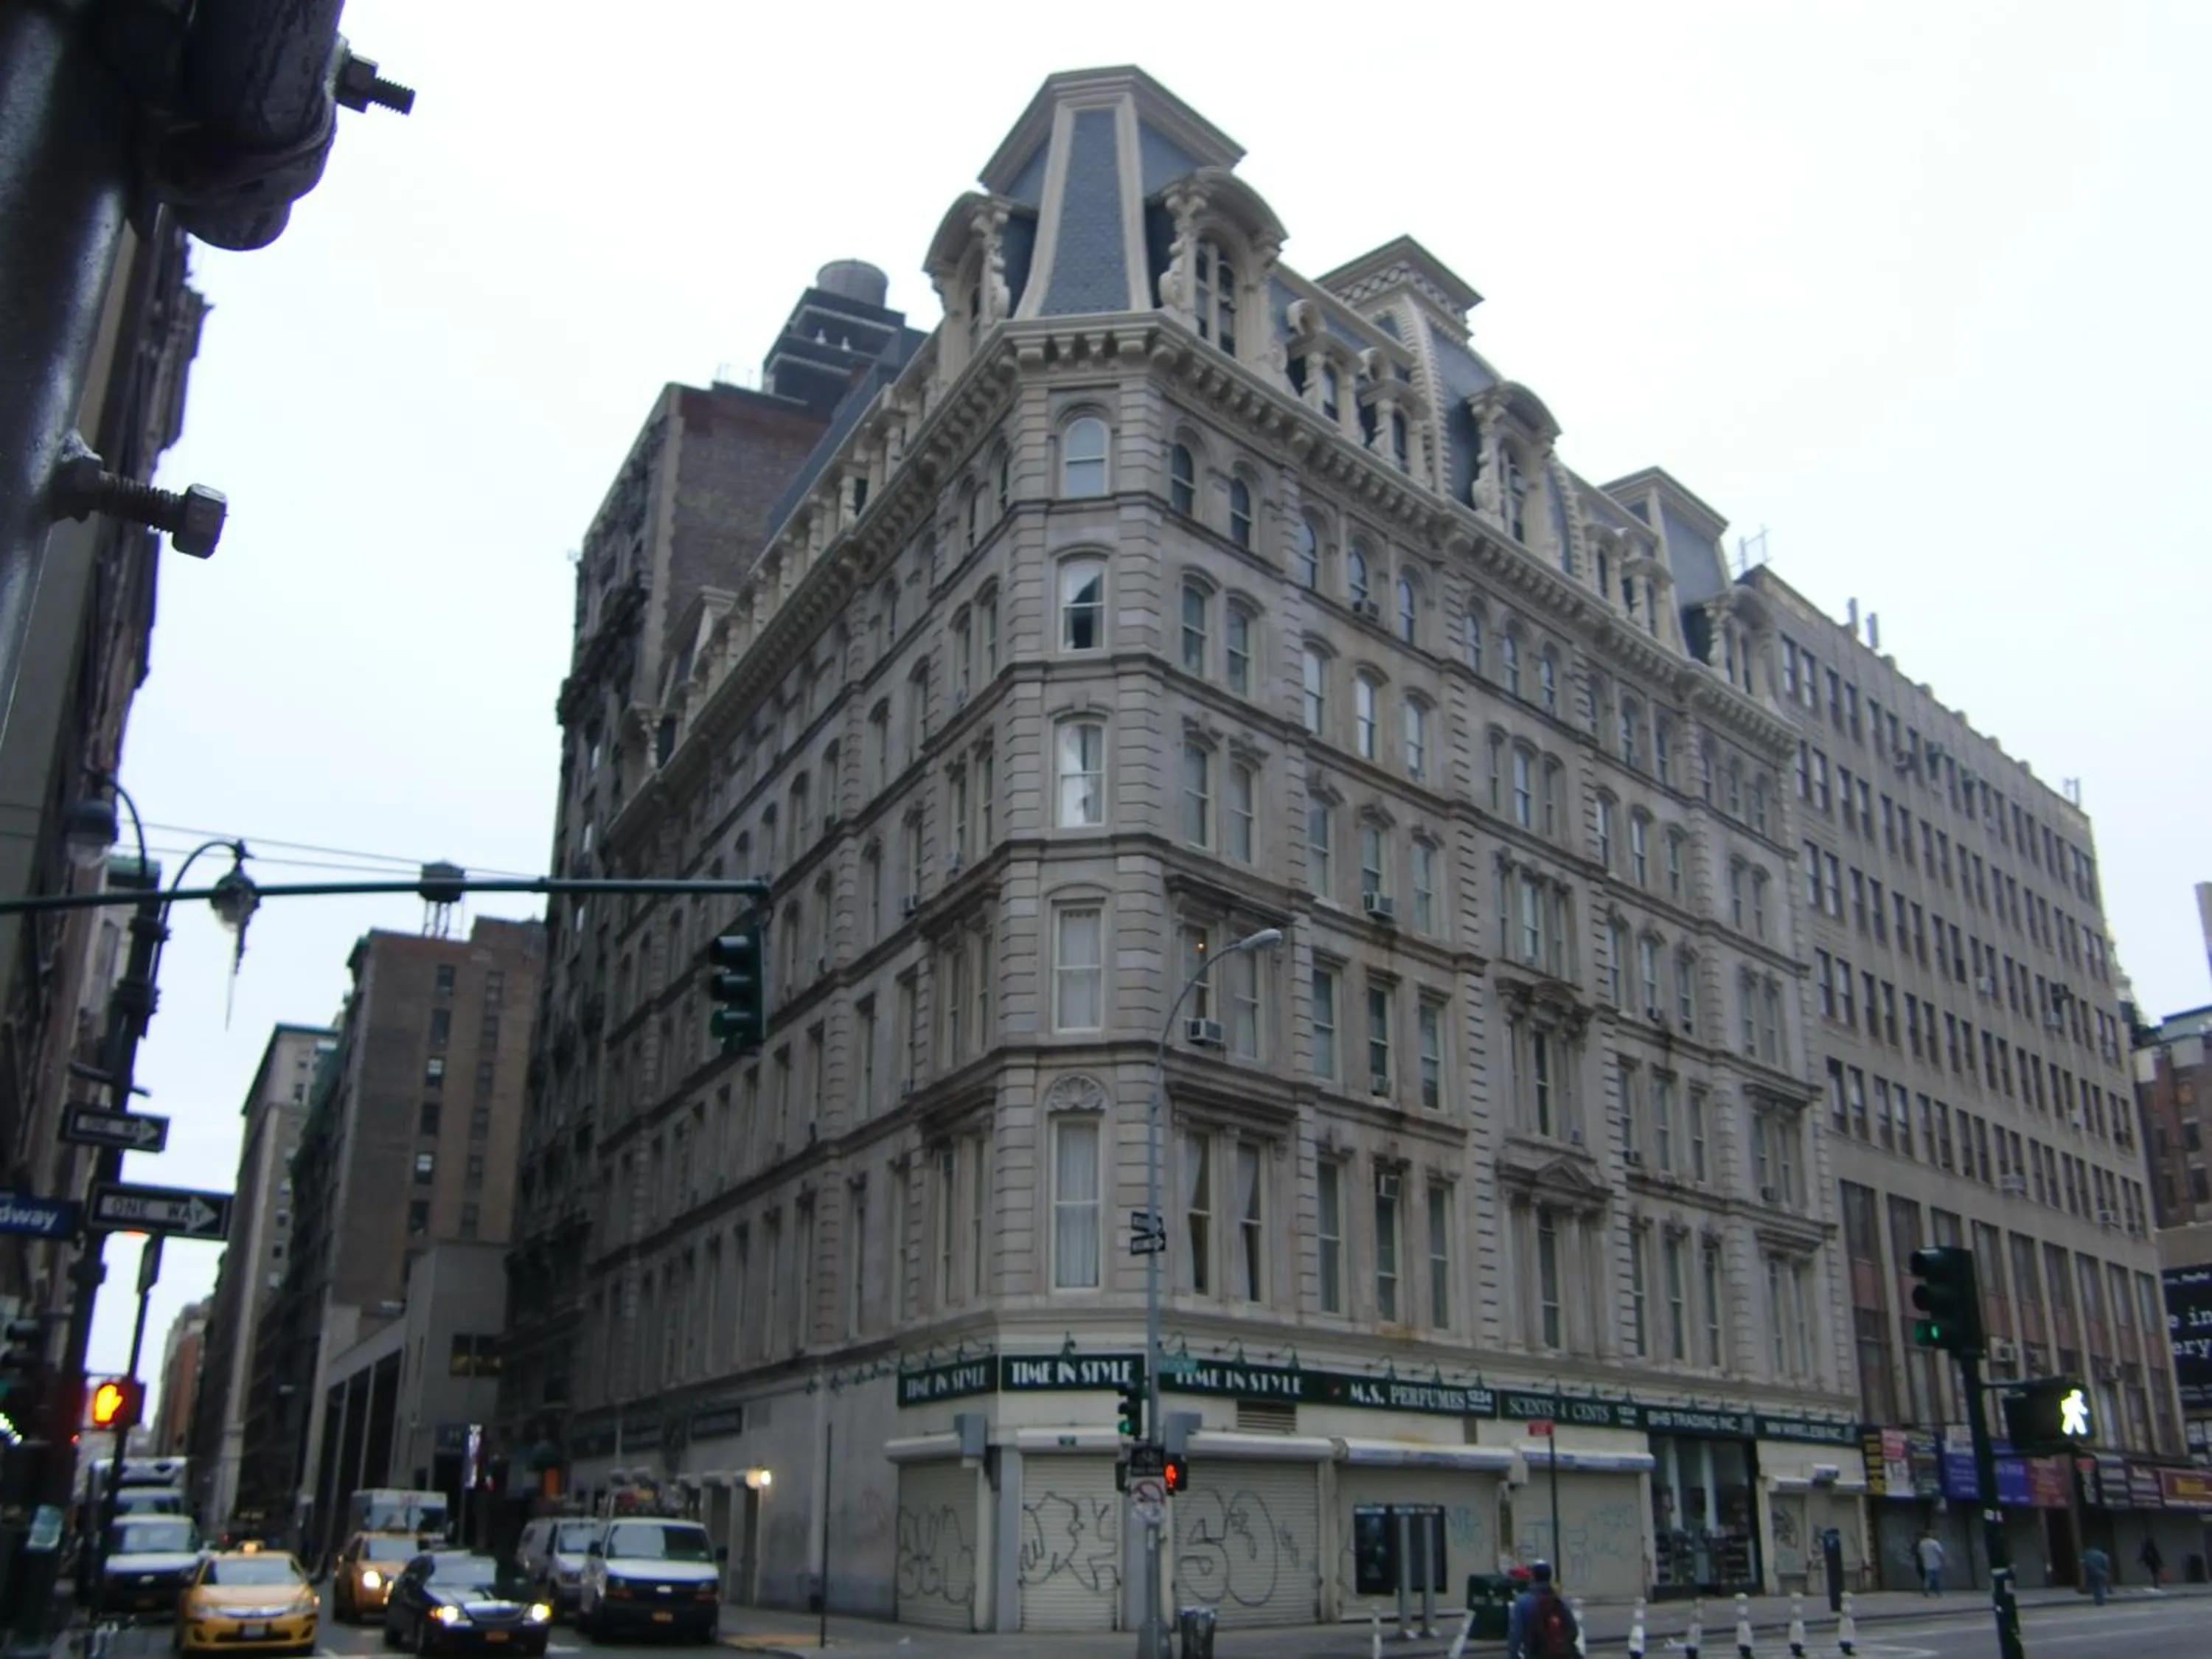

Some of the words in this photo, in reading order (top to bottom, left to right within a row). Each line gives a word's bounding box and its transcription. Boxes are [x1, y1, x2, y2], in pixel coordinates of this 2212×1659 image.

[168, 1201, 204, 1222] WAY
[905, 1375, 930, 1398] TIME
[934, 1372, 947, 1394] IN
[951, 1363, 985, 1391] STYLE
[1012, 1360, 1052, 1384] TIME
[1057, 1361, 1076, 1383] IN
[1081, 1360, 1133, 1384] STYLE
[1175, 1368, 1218, 1388] TIME
[1225, 1368, 1246, 1391] IN
[1249, 1372, 1303, 1395] STYLE
[1349, 1382, 1385, 1405] M.S.
[1389, 1383, 1466, 1411] PERFUMES
[1509, 1396, 1556, 1417] SCENTS
[1571, 1402, 1610, 1424] CENTS
